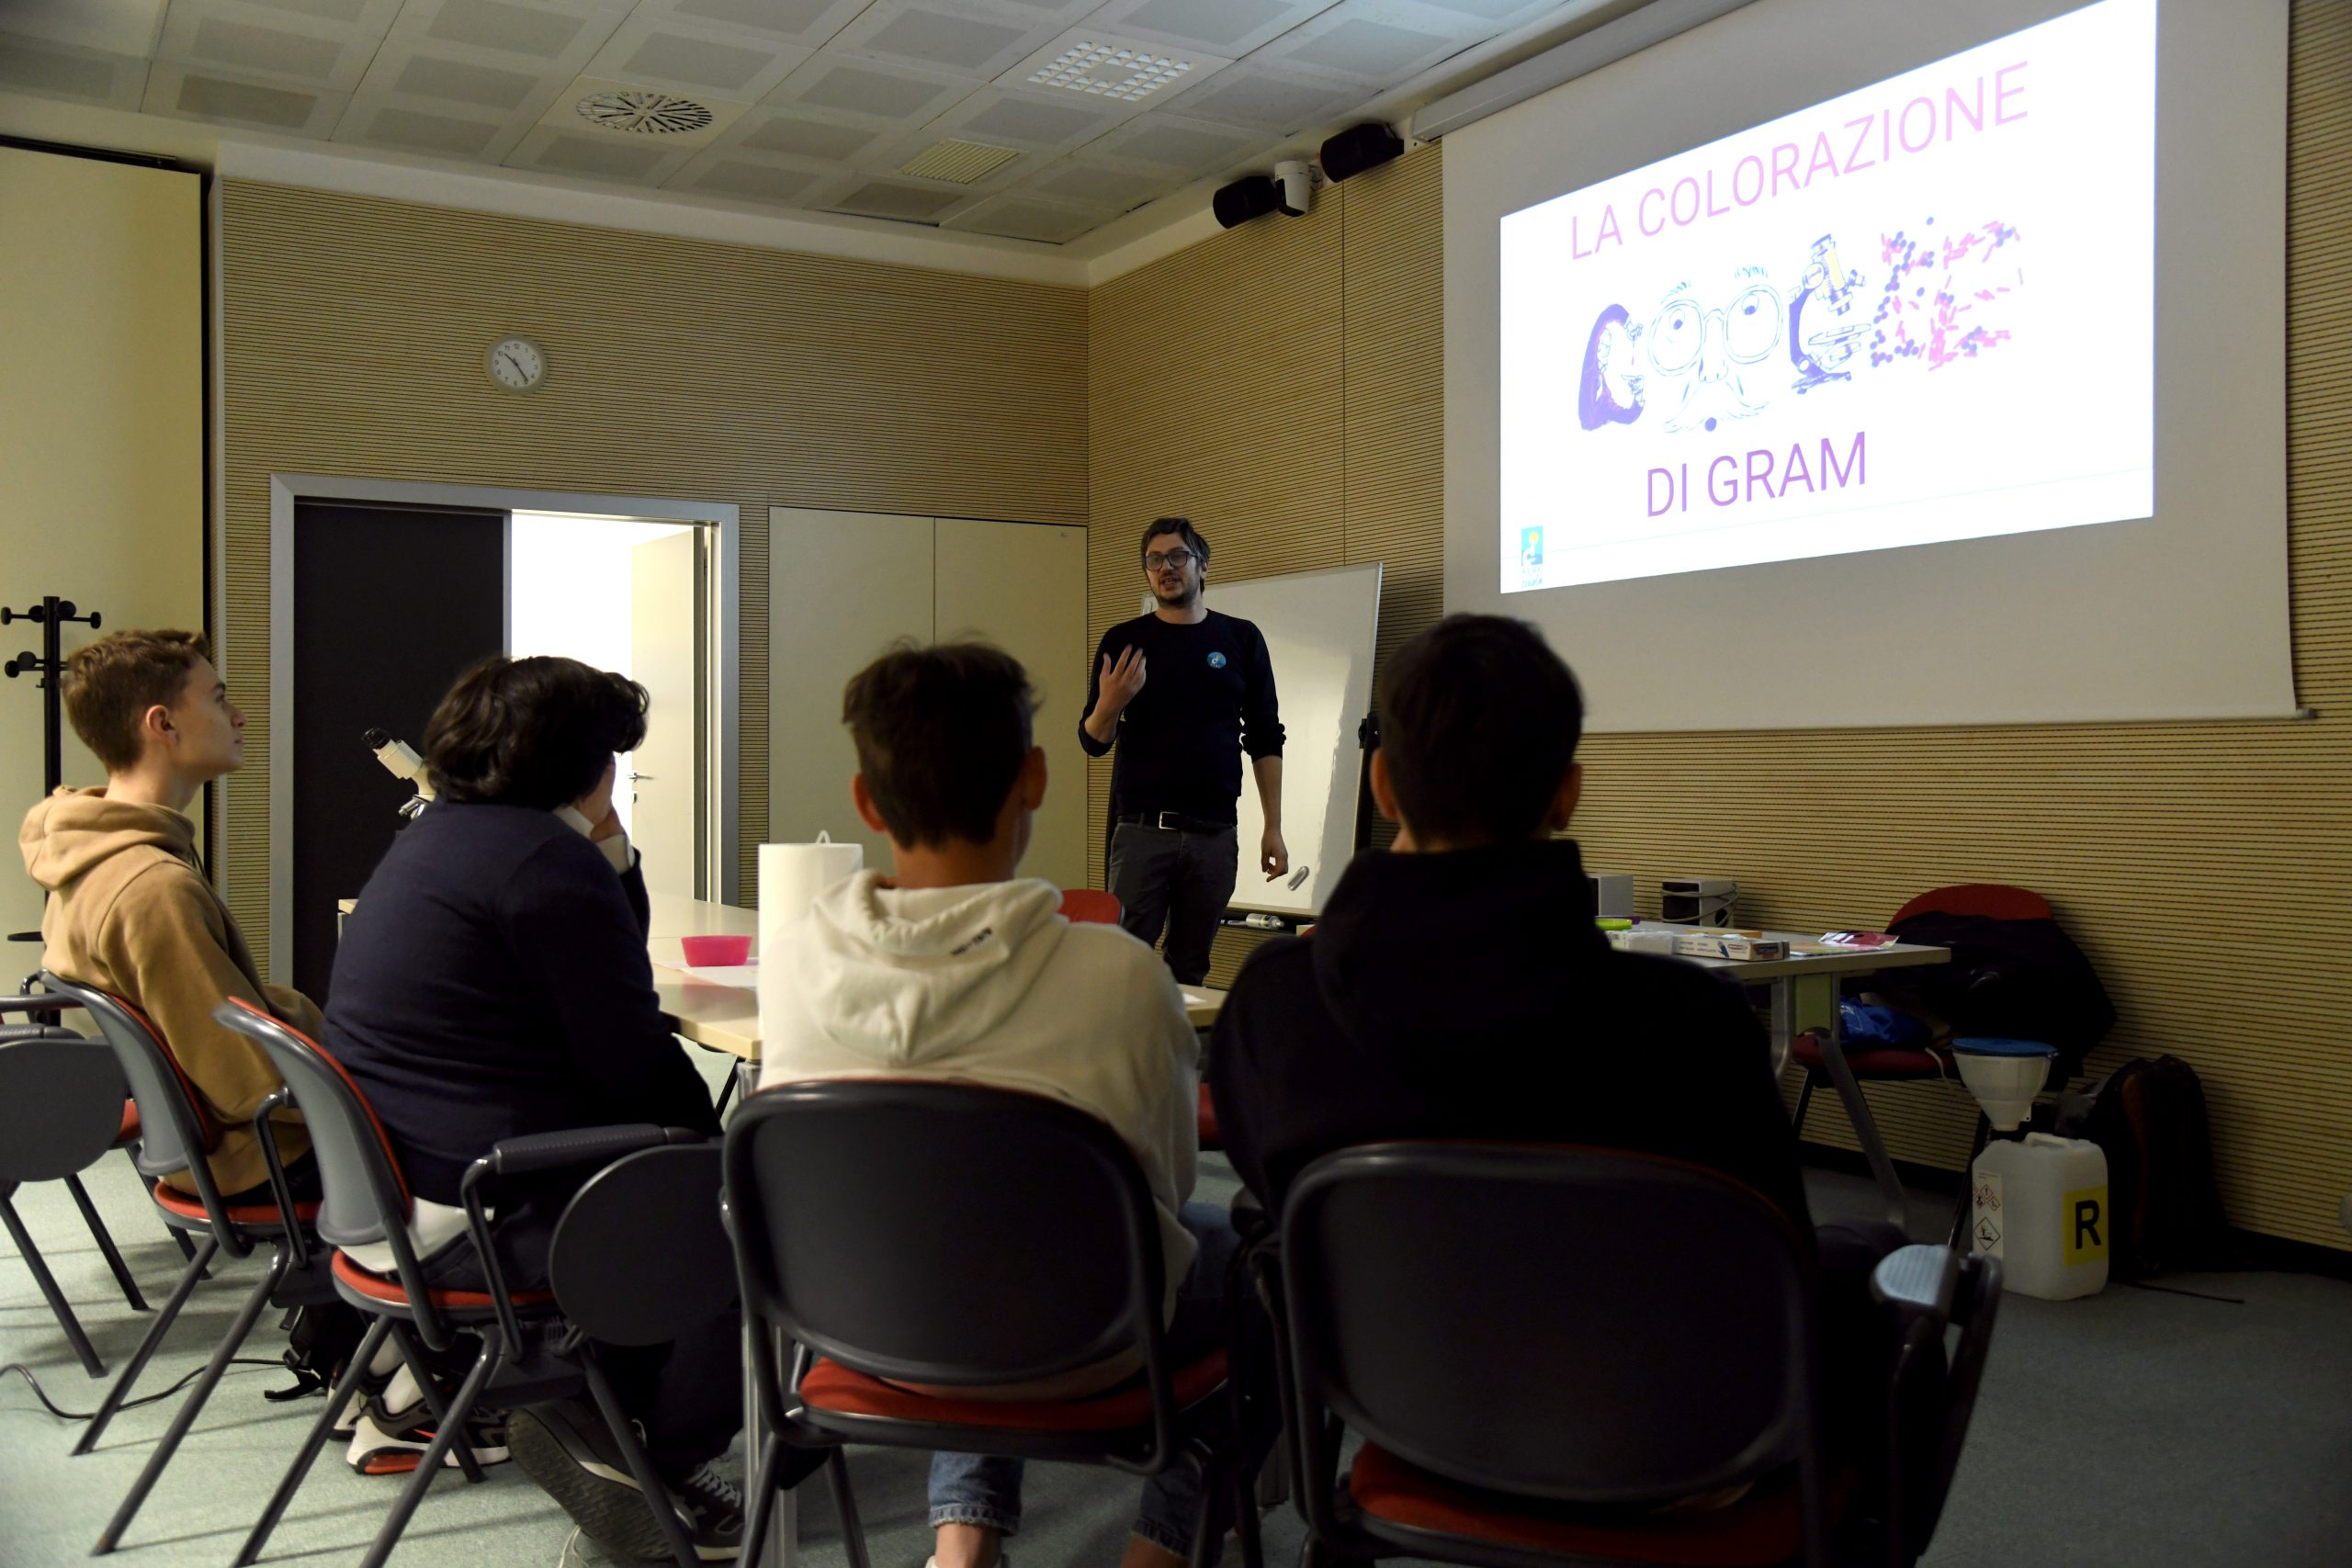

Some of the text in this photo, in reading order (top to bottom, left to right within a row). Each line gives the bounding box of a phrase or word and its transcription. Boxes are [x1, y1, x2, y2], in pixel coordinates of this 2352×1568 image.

[1572, 61, 2028, 260] LA COLORAZIONE
[1647, 431, 1865, 517] DI GRAM
[2075, 1200, 2101, 1250] R
